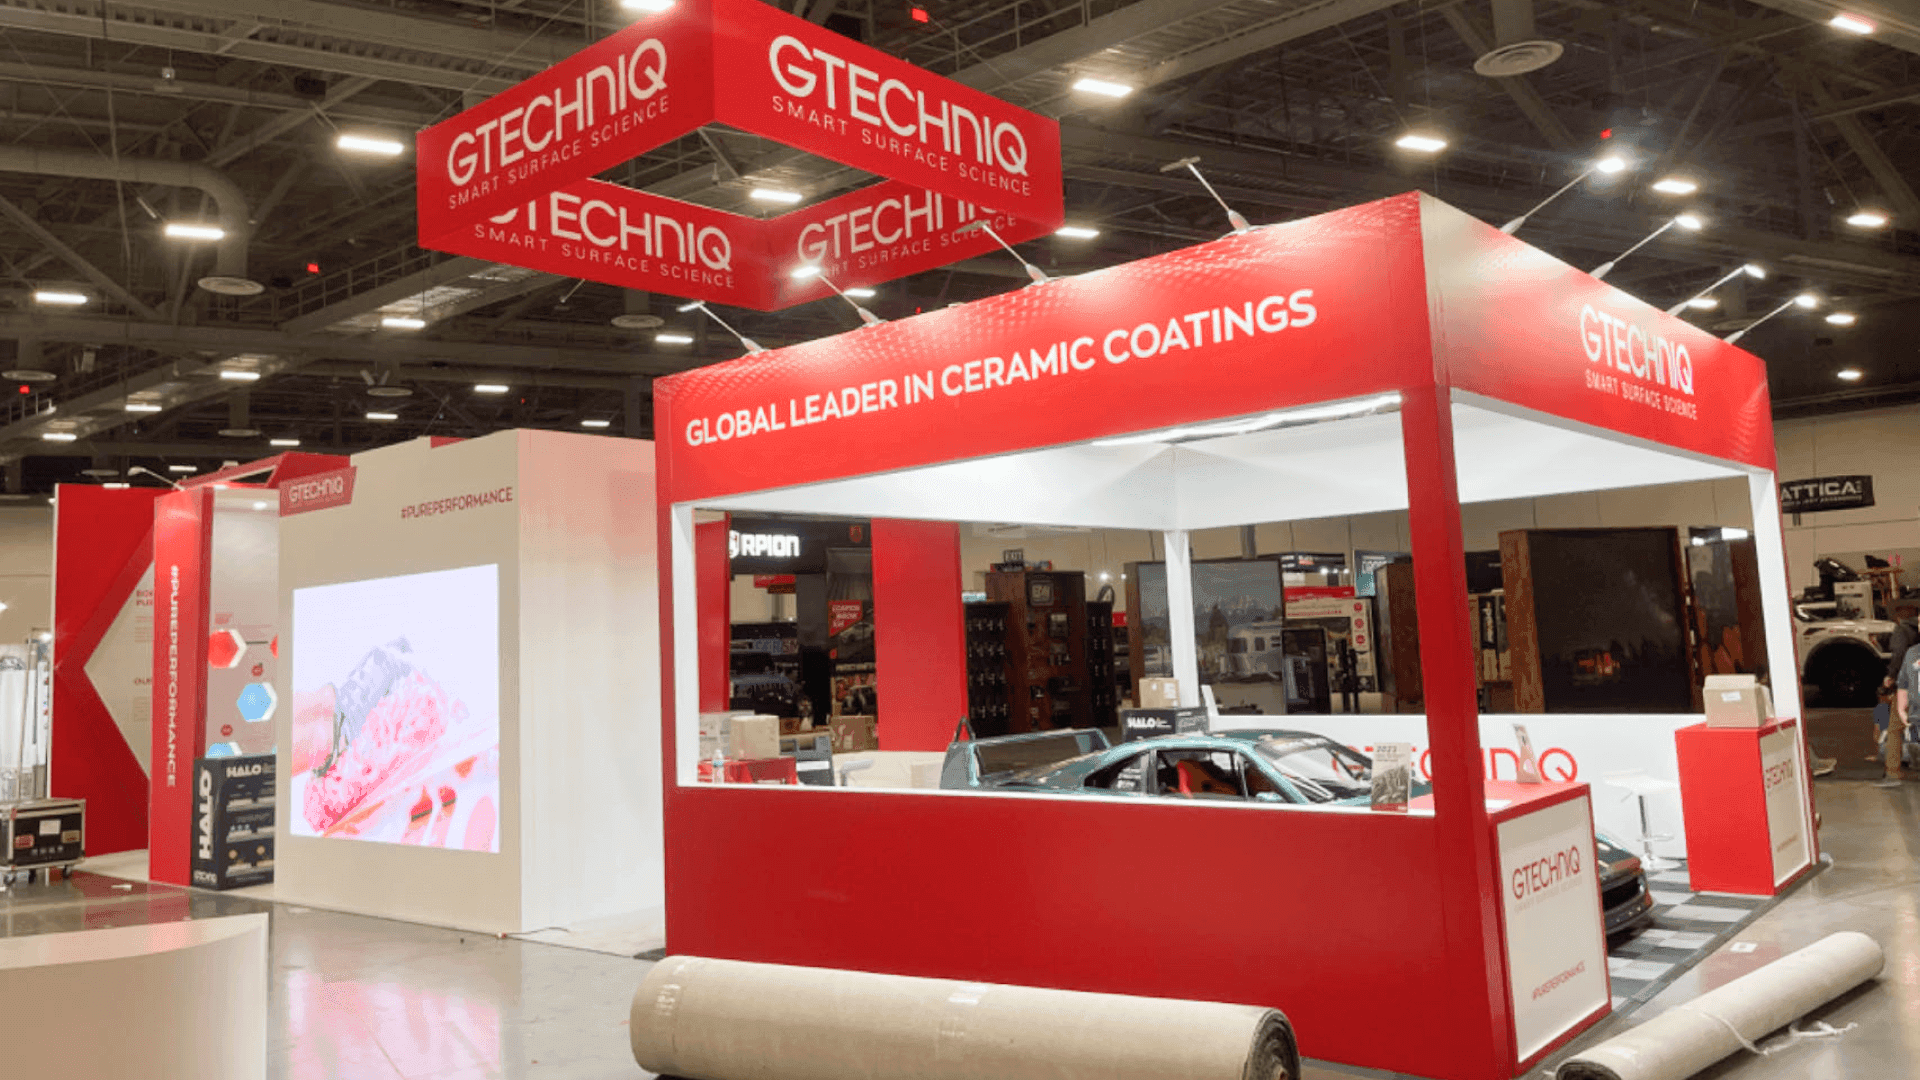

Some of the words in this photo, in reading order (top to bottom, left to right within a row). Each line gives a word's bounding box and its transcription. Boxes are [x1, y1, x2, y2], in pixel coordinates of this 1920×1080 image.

[448, 38, 667, 186] GTECHNIQ
[769, 35, 1028, 177] GTECHNIQ
[772, 95, 848, 136] SMART
[861, 127, 949, 172] SURFACE
[958, 162, 1031, 197] SCIENCE
[449, 176, 500, 209] SMART
[508, 139, 582, 184] SURFACE
[591, 95, 669, 148] SCIENCE
[474, 223, 549, 251] SMART
[562, 243, 649, 273] SURFACE
[660, 263, 734, 289] SCIENCE
[489, 191, 732, 272] ECHNIQ
[858, 238, 931, 269] SURFACE
[685, 403, 785, 446] GLOBAL
[790, 379, 898, 427] LEADER
[904, 370, 934, 405] IN
[941, 336, 1096, 396] CERAMIC
[1103, 289, 1317, 364] COATINGS
[1580, 304, 1694, 395] GTECHNIQ
[1585, 368, 1618, 395] SMART
[1621, 380, 1661, 410] SURFACE
[1664, 394, 1698, 420] SCIENCE
[289, 476, 344, 504] GTECHNIQ
[401, 486, 513, 520] #PUREPERFORMANCE
[167, 565, 180, 788] #PUREPERFORMANCE
[226, 764, 261, 778] HALO
[198, 769, 213, 859] HALO
[1512, 845, 1580, 900] GTECHNIQ
